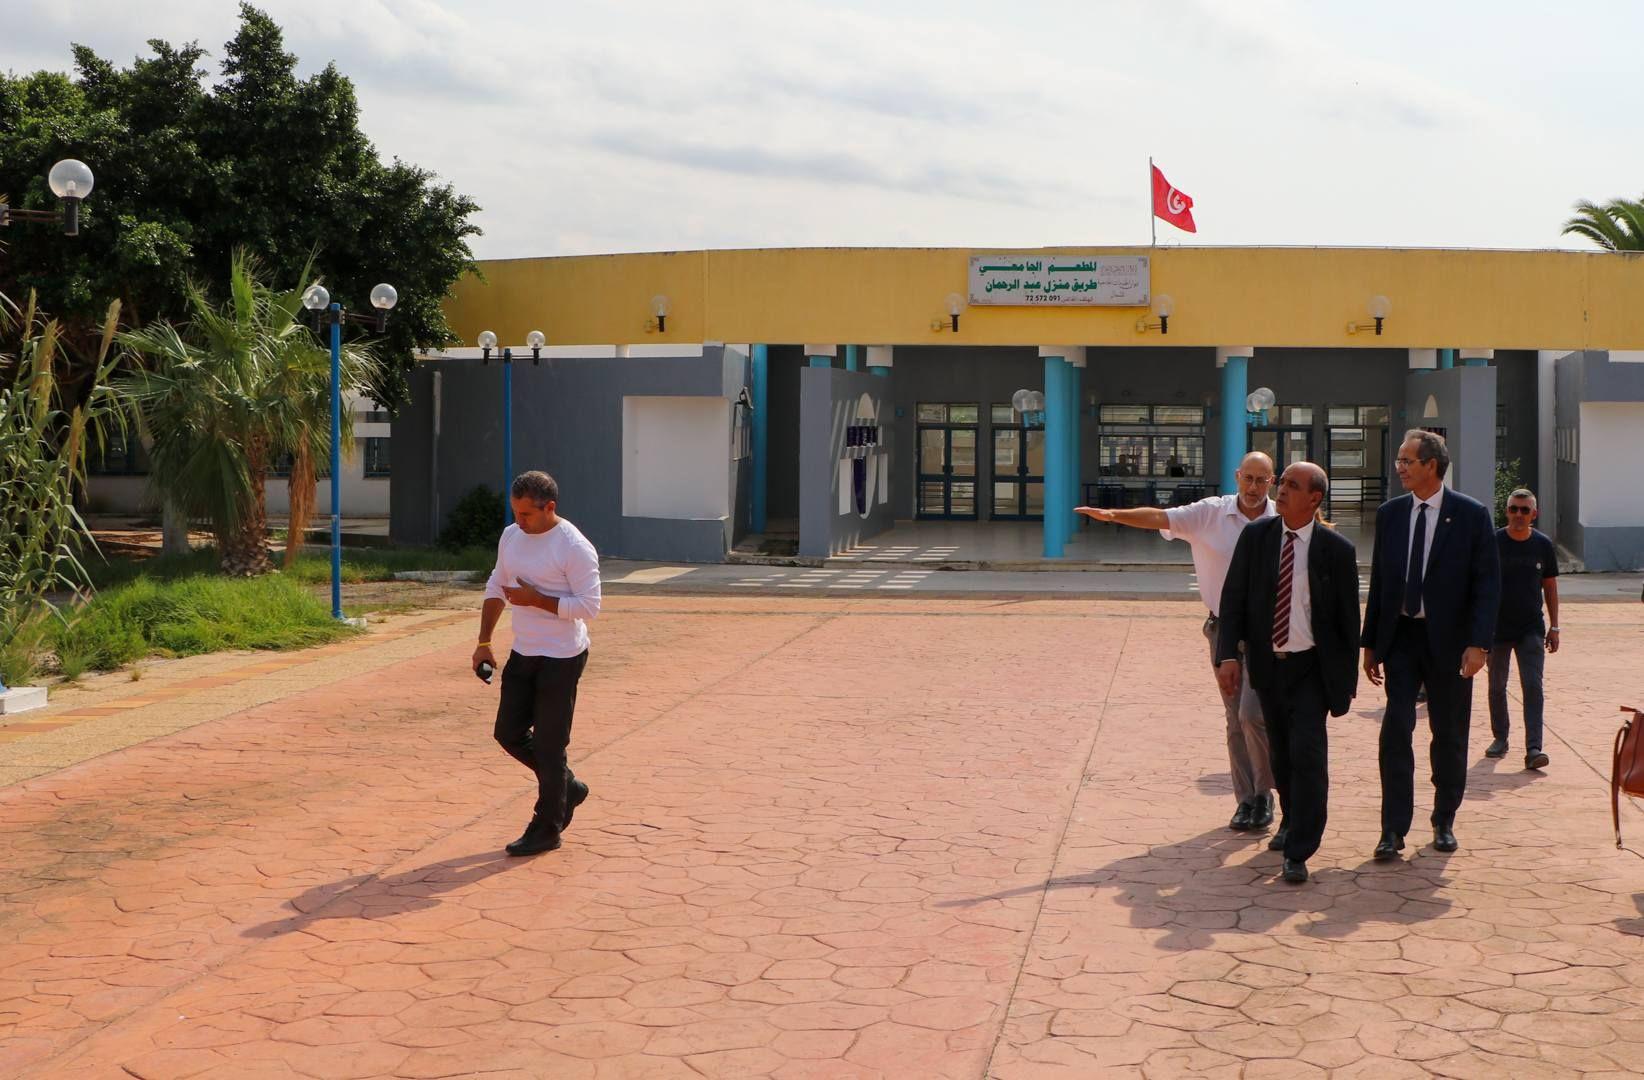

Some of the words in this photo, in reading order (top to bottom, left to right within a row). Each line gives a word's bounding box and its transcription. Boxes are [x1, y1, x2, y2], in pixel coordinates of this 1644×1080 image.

[985, 279, 1020, 293] الرحمان
[1023, 279, 1041, 293] عبد
[1043, 279, 1070, 293] منزل
[1071, 278, 1098, 292] طريق
